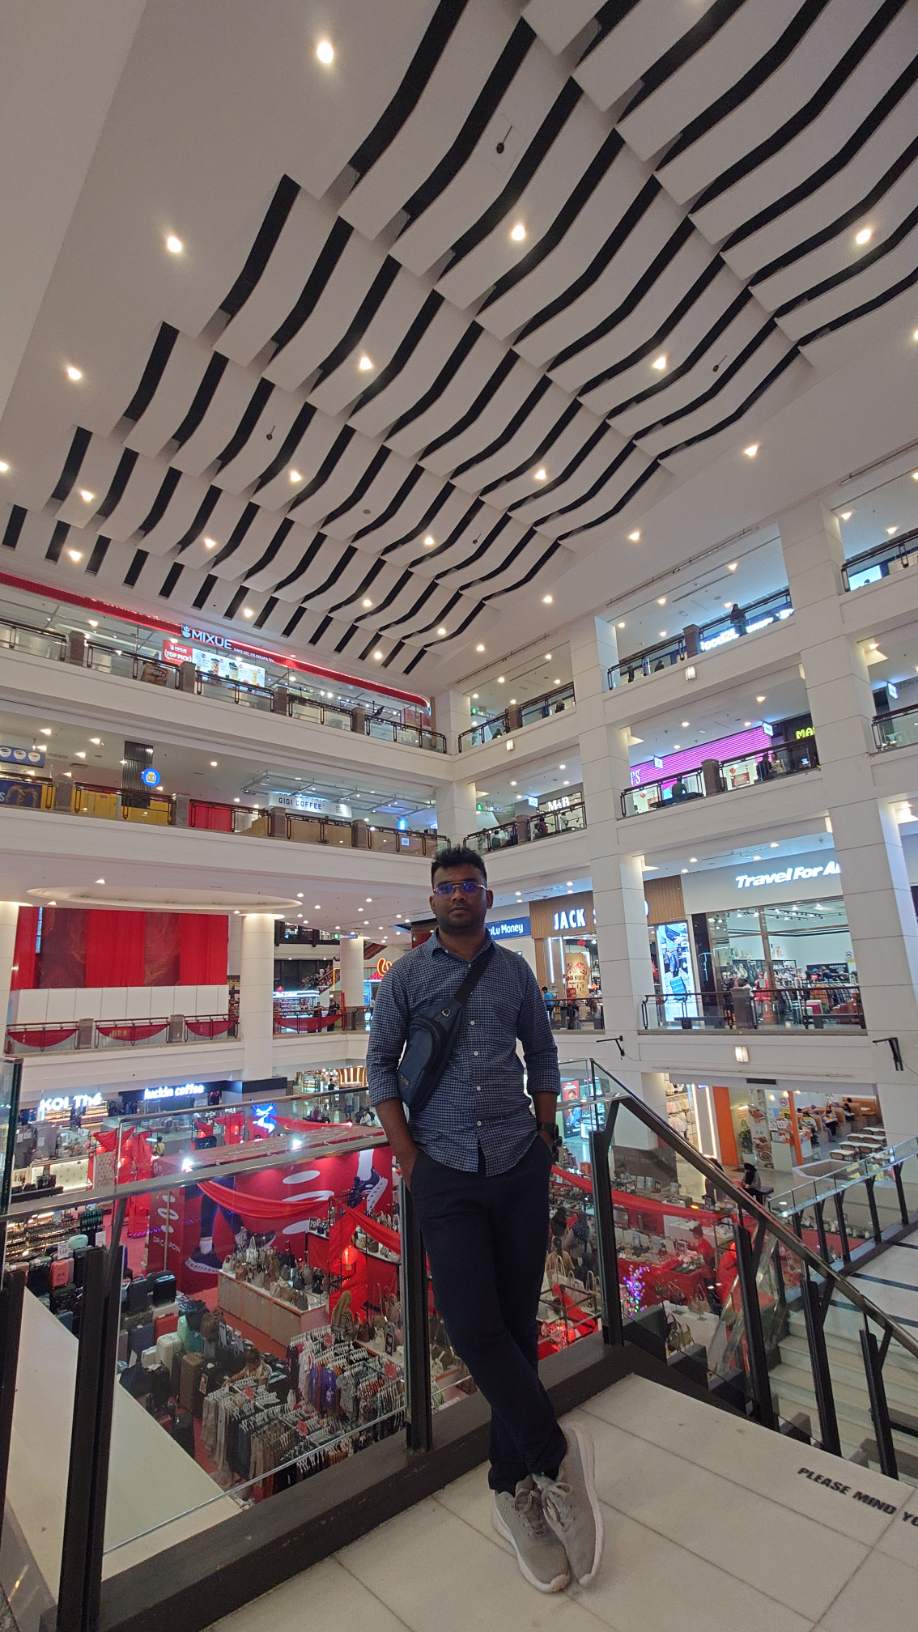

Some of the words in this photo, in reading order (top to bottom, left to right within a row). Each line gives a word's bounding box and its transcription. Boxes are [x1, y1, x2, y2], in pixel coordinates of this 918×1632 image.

[191, 630, 233, 650] MIXUE
[279, 797, 293, 806] GIGI
[295, 800, 322, 810] COFFEE
[736, 867, 794, 888] Travel
[793, 865, 823, 880] For
[501, 923, 524, 934] Money
[553, 908, 586, 930] JACK
[174, 1083, 204, 1097] coffee
[797, 1467, 852, 1496] PLEASE
[852, 1491, 897, 1515] MIND
